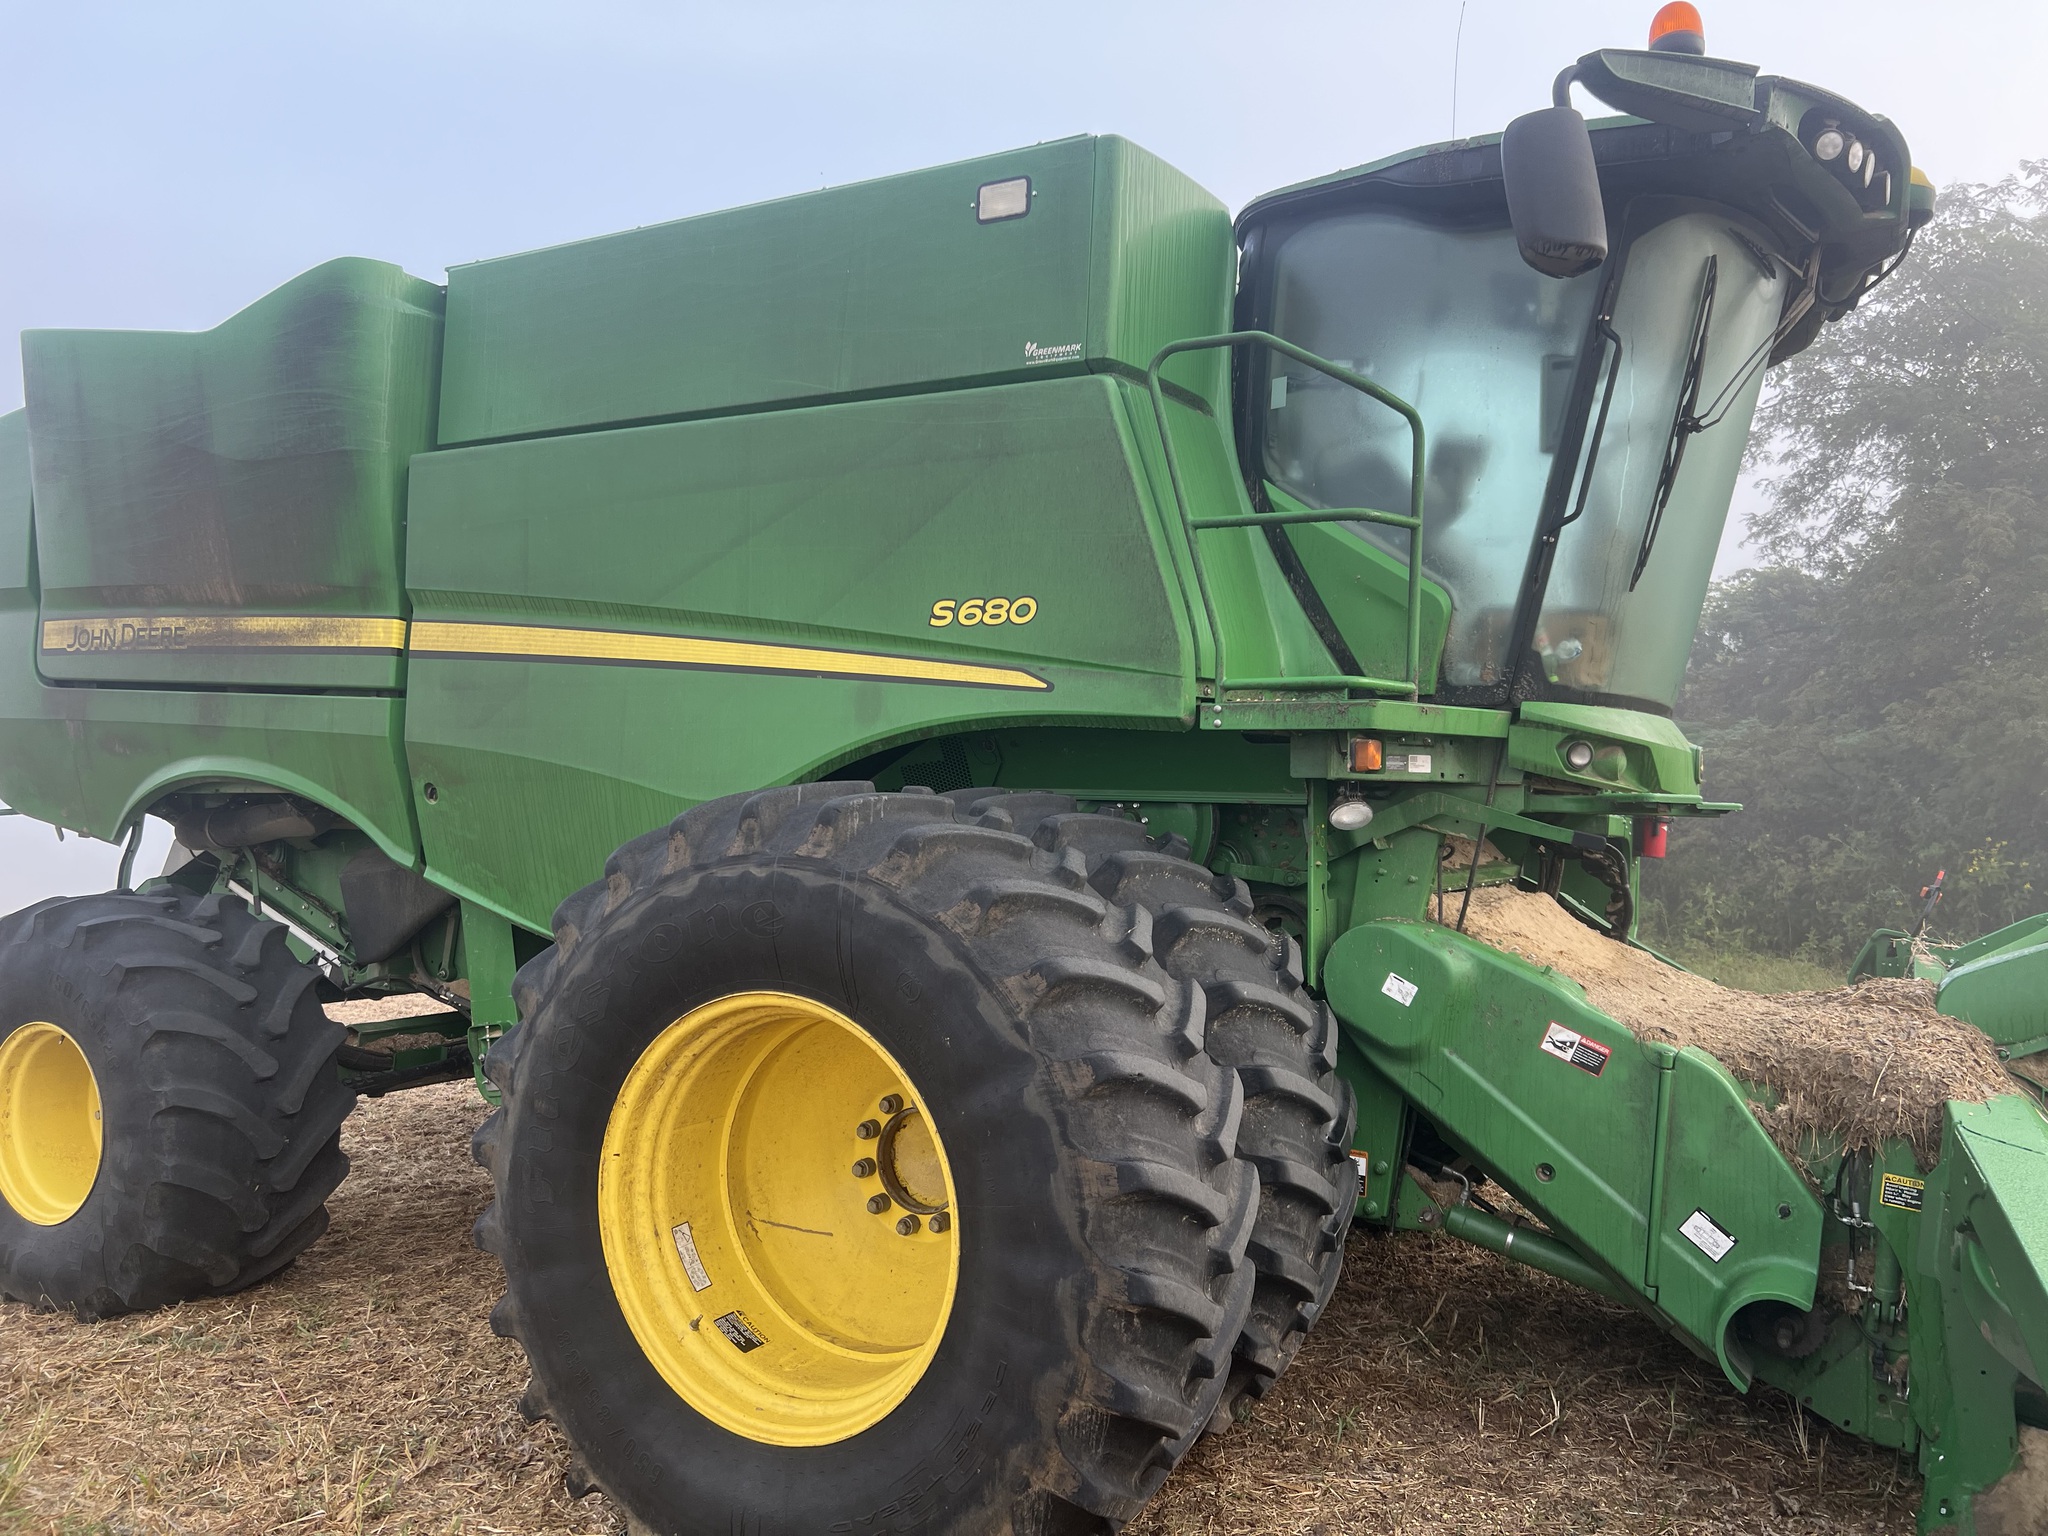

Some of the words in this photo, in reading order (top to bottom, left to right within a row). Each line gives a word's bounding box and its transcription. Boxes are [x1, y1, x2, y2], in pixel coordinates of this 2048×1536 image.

[1032, 342, 1082, 357] GREENMARK
[928, 595, 1039, 628] S680
[66, 625, 117, 649] JOHN
[121, 623, 186, 648] DEERE
[1587, 1040, 1610, 1055] DANGER
[742, 1316, 771, 1344] CAUTION
